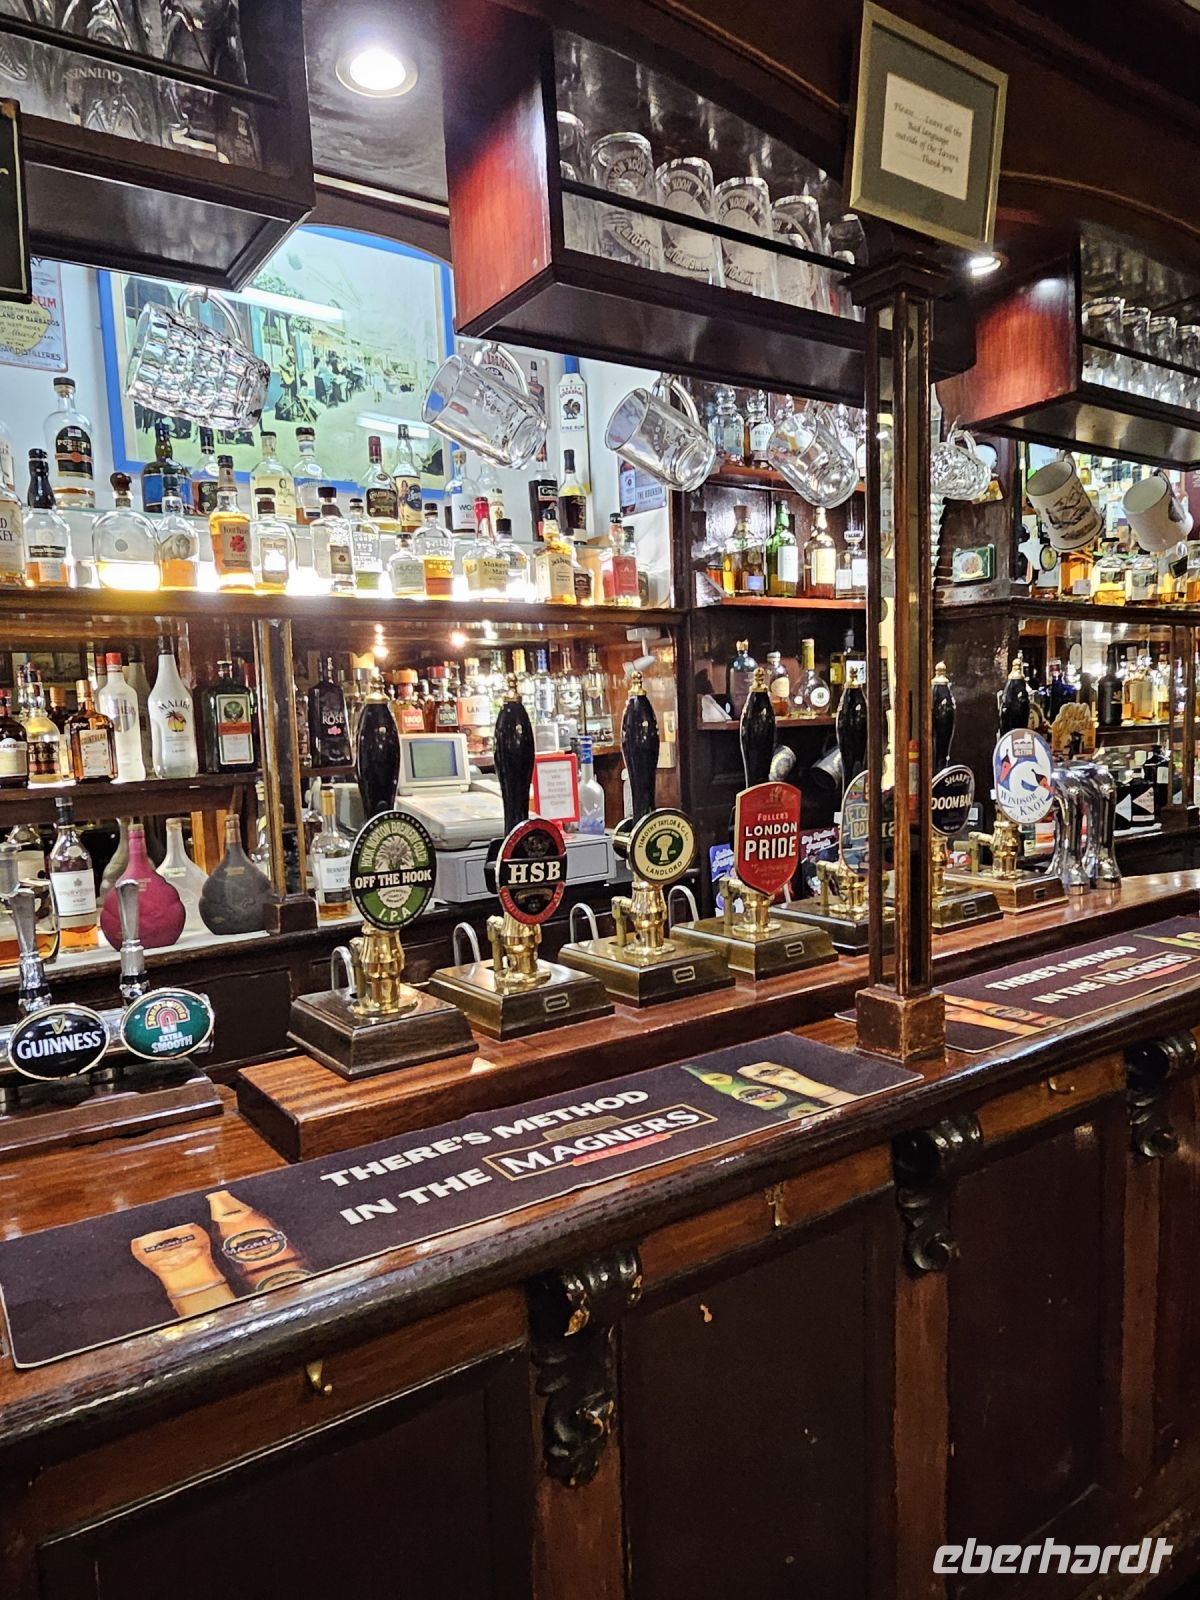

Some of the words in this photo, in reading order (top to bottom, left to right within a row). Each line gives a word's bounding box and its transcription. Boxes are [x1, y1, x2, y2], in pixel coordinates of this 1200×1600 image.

[26, 315, 60, 327] BARBADOS
[322, 715, 344, 726] ROSE
[1001, 790, 1037, 805] WINDSOR
[1019, 797, 1046, 817] KNOT
[637, 823, 658, 849] TIMOTHY
[657, 819, 677, 827] TAYLOR
[745, 821, 798, 838] LONDON
[744, 835, 798, 862] PRIDE
[354, 876, 376, 889] OFF
[378, 872, 400, 887] THE
[402, 869, 433, 884] HOOK
[508, 860, 562, 885] HSB
[645, 860, 683, 876] LANDLORD
[984, 962, 1062, 992] THERE'S
[1061, 945, 1138, 971] METHOD
[1031, 991, 1069, 1005] IN
[1061, 980, 1107, 996] THE
[1094, 952, 1194, 984] MAGNERS
[16, 1030, 102, 1061] GUINNESS
[151, 1034, 193, 1053] SMOOTH
[158, 1031, 183, 1043] EXTRA
[319, 1131, 492, 1187] THERE'S
[491, 1090, 649, 1140] METHOD
[339, 1198, 398, 1225] IN
[398, 1167, 493, 1206] THE
[498, 1110, 701, 1176] MAGNERS
[226, 1232, 287, 1256] MAGNERS
